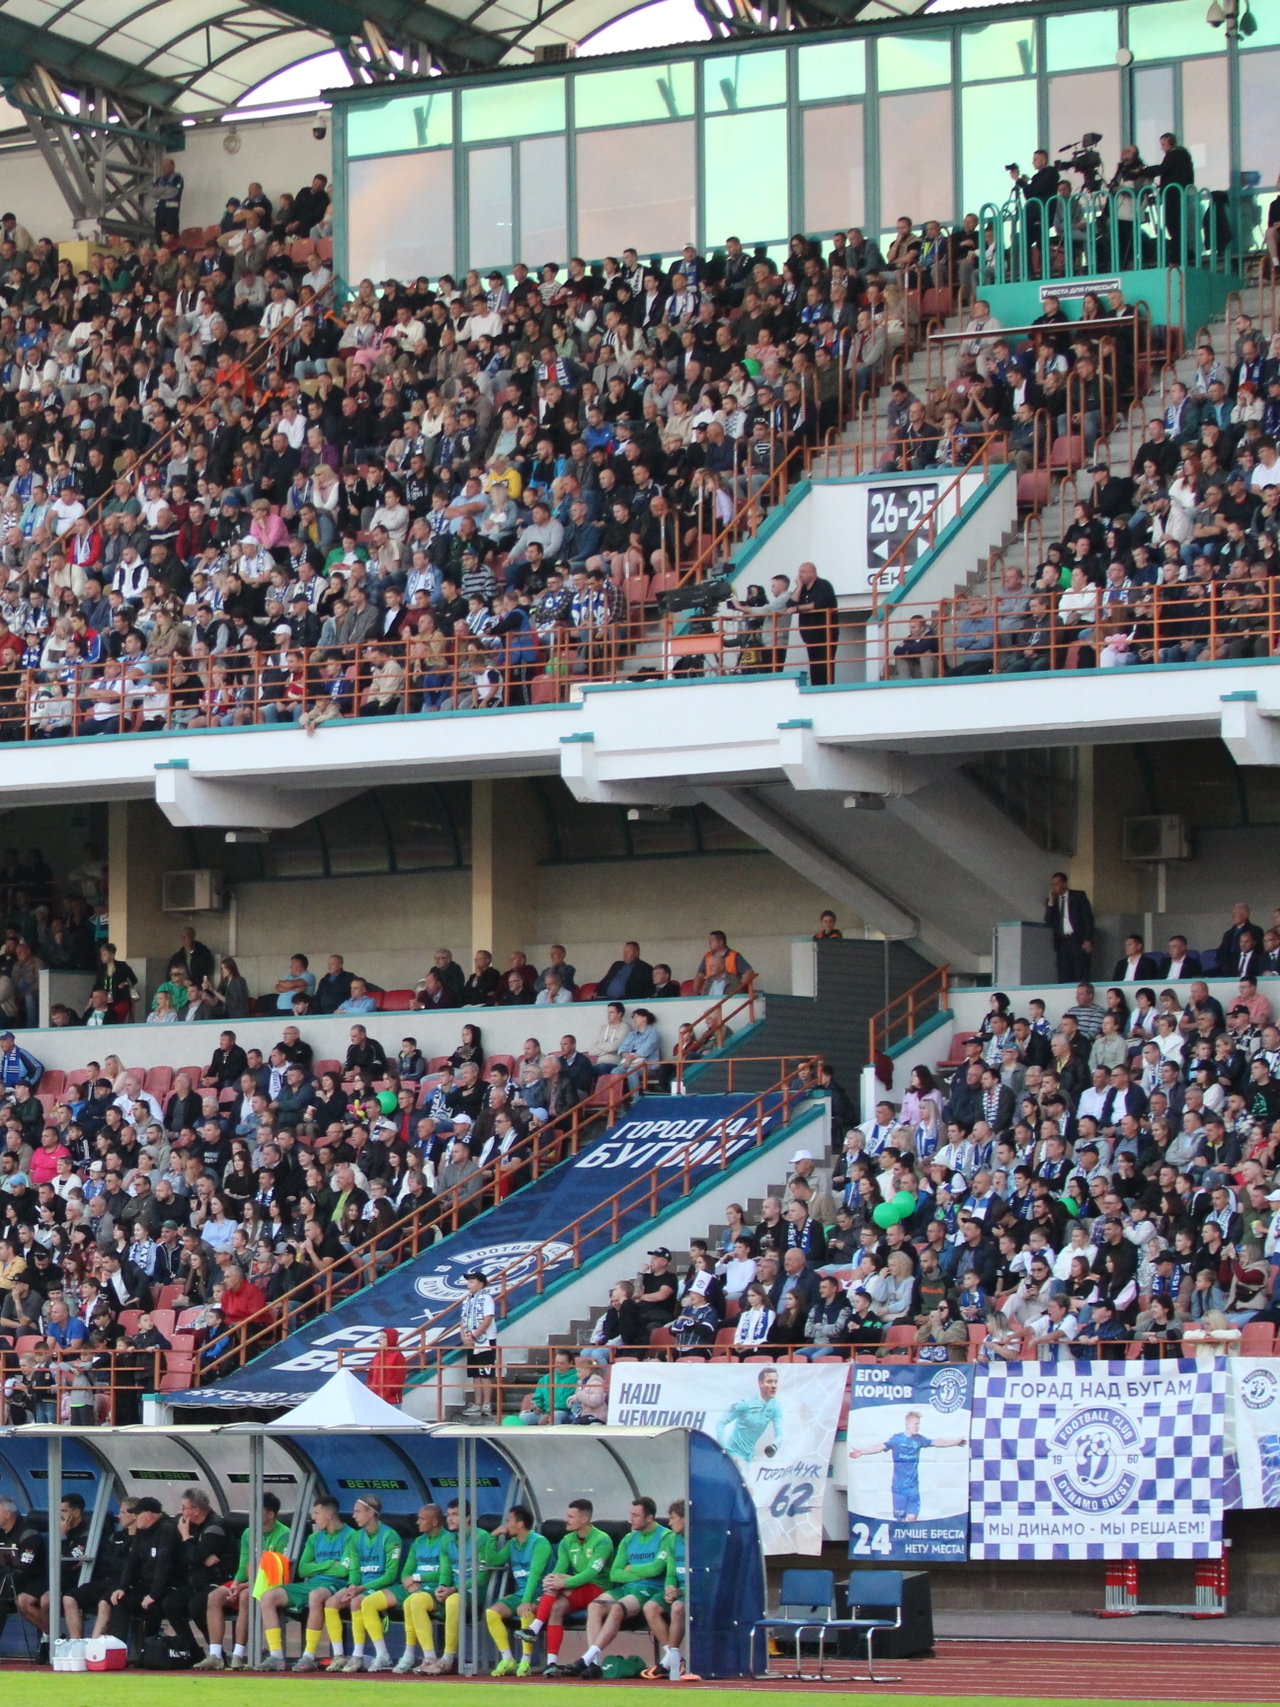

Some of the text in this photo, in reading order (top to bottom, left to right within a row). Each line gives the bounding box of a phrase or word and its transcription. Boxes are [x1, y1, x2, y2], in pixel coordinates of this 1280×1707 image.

[1047, 288, 1069, 296] МЕСТА
[1069, 285, 1084, 294] ДЛЯ
[871, 489, 936, 534] 26-25
[867, 572, 905, 586] СЕК
[610, 1118, 710, 1140] ГОРОД
[434, 1264, 453, 1273] 19
[423, 1280, 464, 1298] DYNAMO
[856, 1368, 891, 1382] ЕГОР
[618, 1382, 662, 1406] НАШ
[854, 1384, 913, 1401] КОРЦОВ
[1010, 1379, 1193, 1399] ГОРАД НАД БУГАМ
[618, 1409, 707, 1430] ЧЕМПИОН
[1060, 1410, 1133, 1441] FOOTBALL CLUB
[1052, 1454, 1063, 1465] 19
[1127, 1453, 1139, 1464] 60
[139, 1470, 191, 1481] BETERA
[346, 1479, 399, 1490] BETERA
[770, 1482, 821, 1518] 62
[1058, 1479, 1132, 1511] DYNAMO BREST
[894, 1529, 965, 1540] ЛУЧШЕ БРЕСТА
[989, 1522, 1013, 1536] МЫ
[1018, 1522, 1085, 1538] ДИНАМО
[1100, 1522, 1125, 1536] МЫ
[1131, 1521, 1205, 1536] РЕШАЕМ!
[852, 1522, 892, 1555] 24
[905, 1543, 965, 1555] НЕТУ МЕСТА!
